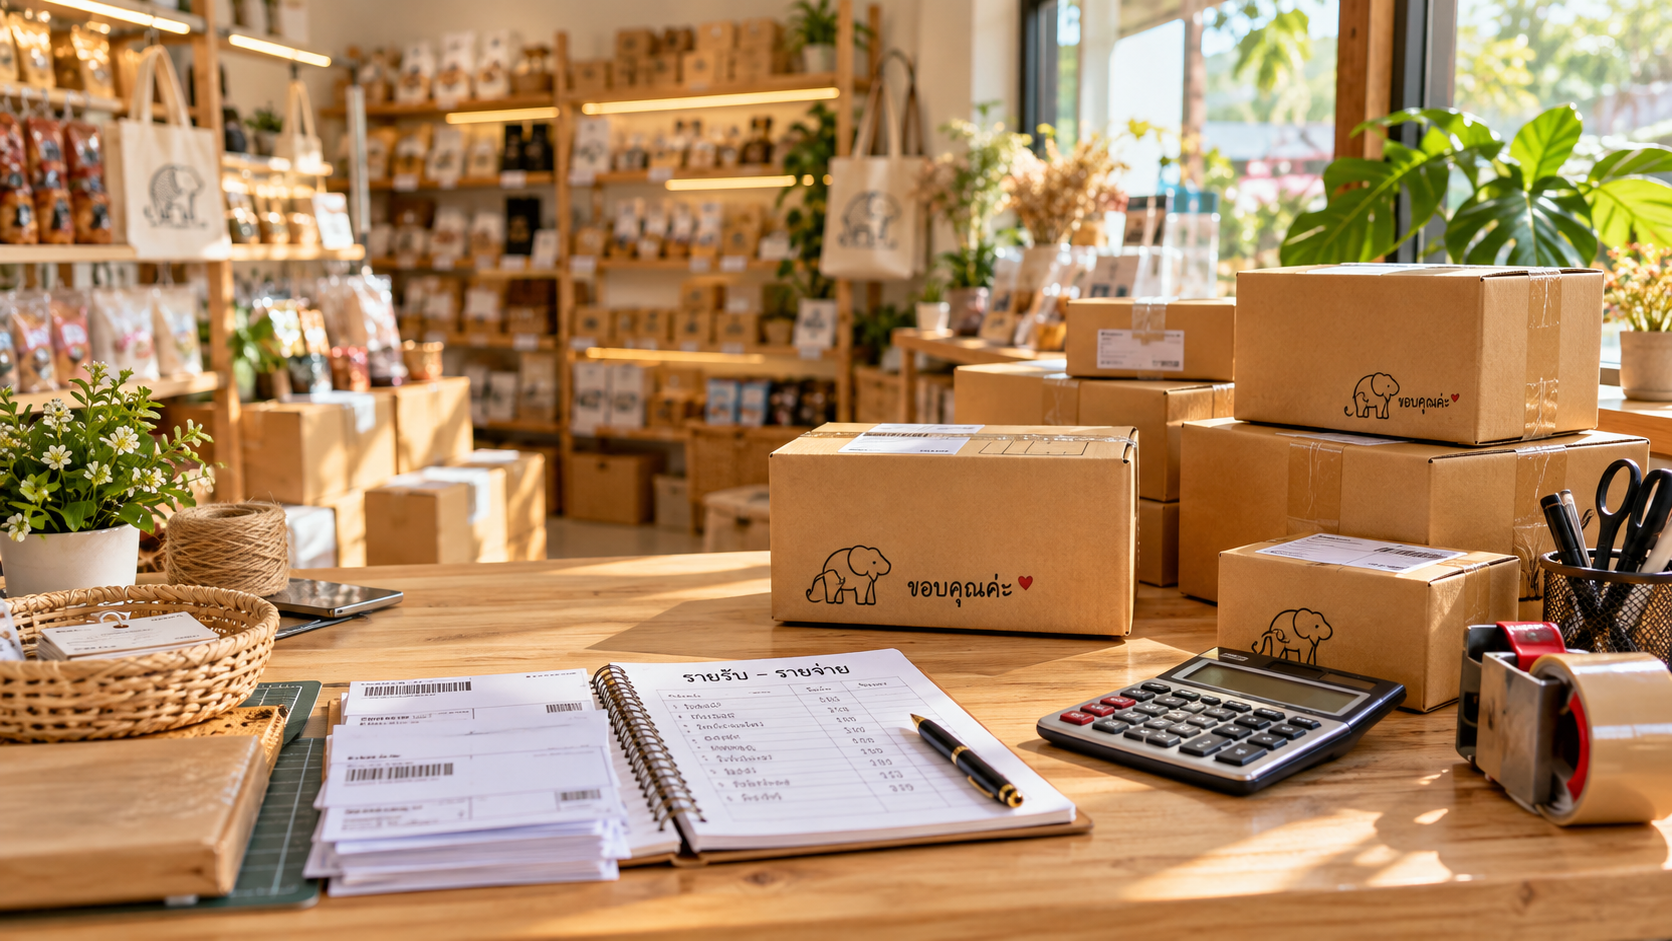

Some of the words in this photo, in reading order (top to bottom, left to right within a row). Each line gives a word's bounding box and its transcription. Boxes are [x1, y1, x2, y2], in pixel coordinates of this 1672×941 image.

[1398, 392, 1449, 415] ขอบคุณค่ะ
[907, 573, 1012, 607] ขอบคุณค่ะ
[775, 663, 850, 679] รายจ่าย
